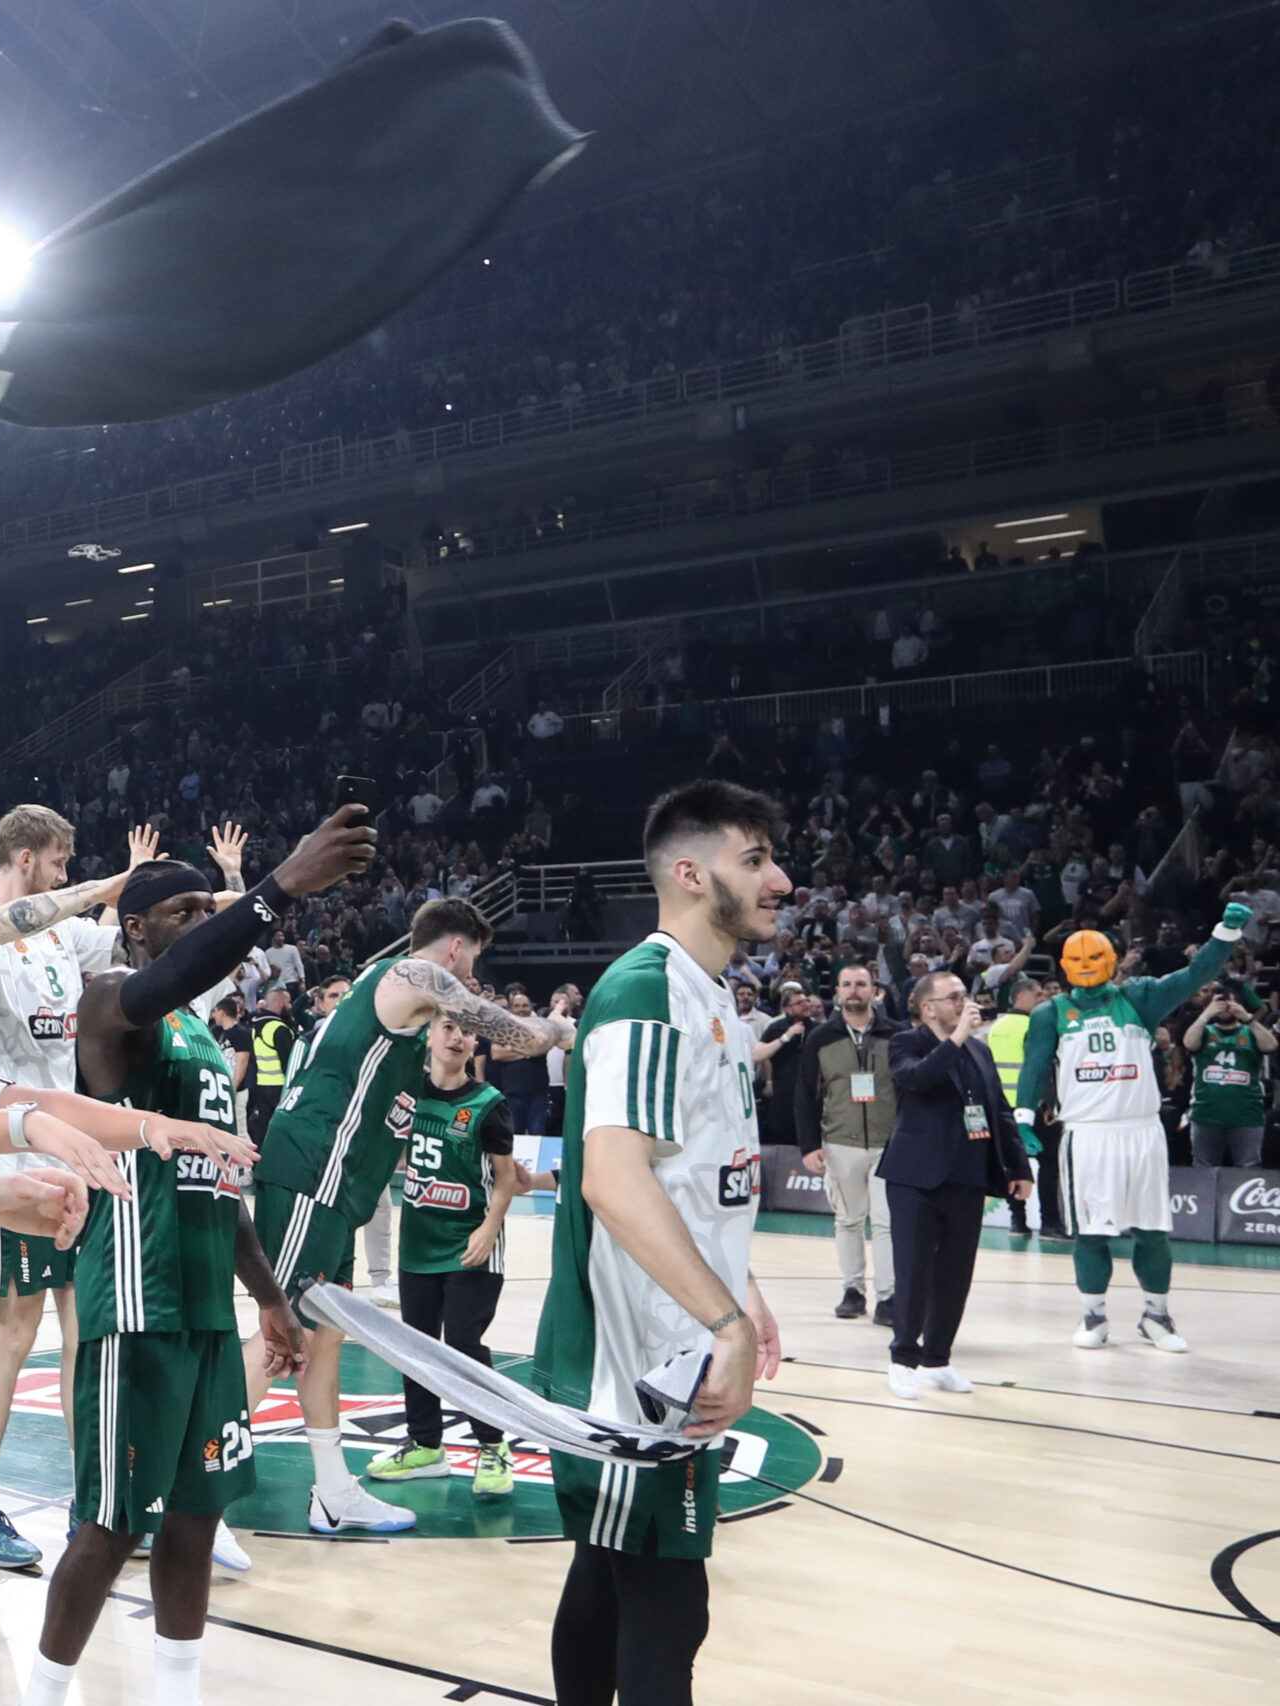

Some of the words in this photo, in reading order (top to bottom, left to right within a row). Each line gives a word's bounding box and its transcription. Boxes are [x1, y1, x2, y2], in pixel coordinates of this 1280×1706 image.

[1089, 1032, 1116, 1053] 08
[1215, 1050, 1236, 1067] 44
[199, 1068, 234, 1125] 25
[411, 1133, 444, 1170] 25
[786, 1169, 824, 1190] ins
[1244, 1222, 1280, 1233] ZER
[681, 1460, 697, 1533] instacar
